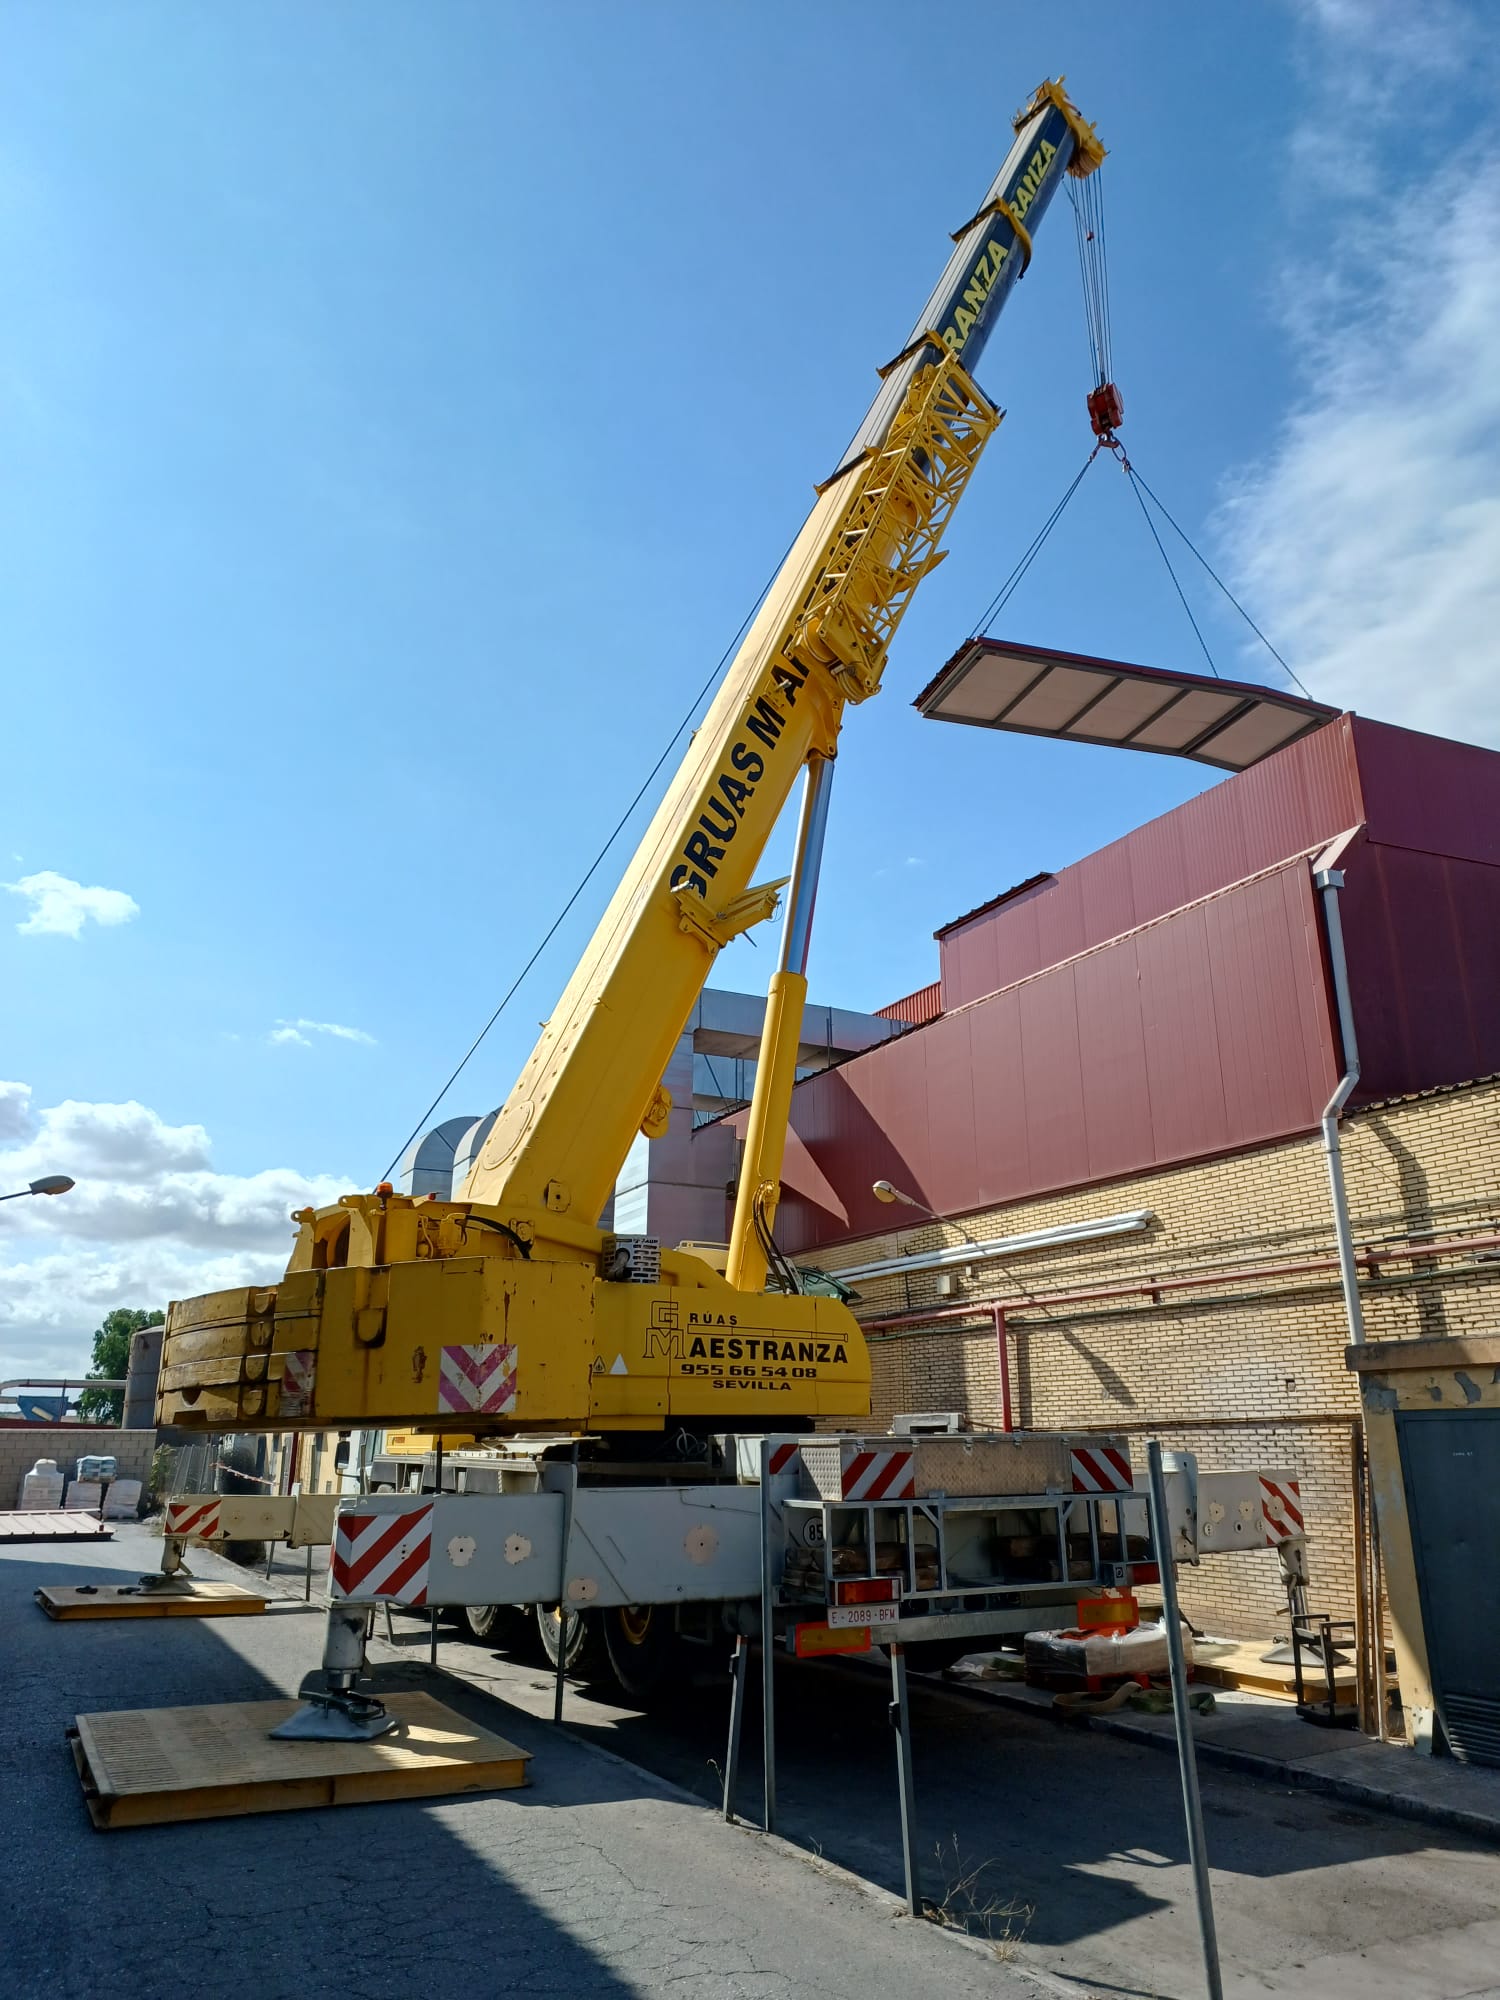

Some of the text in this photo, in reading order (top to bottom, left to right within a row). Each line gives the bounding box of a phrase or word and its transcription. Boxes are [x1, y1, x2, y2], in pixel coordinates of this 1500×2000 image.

[670, 742, 764, 899] GRUAS
[681, 1364, 817, 1378] 955 66 54 08
[712, 1380, 792, 1391] SEVILLA
